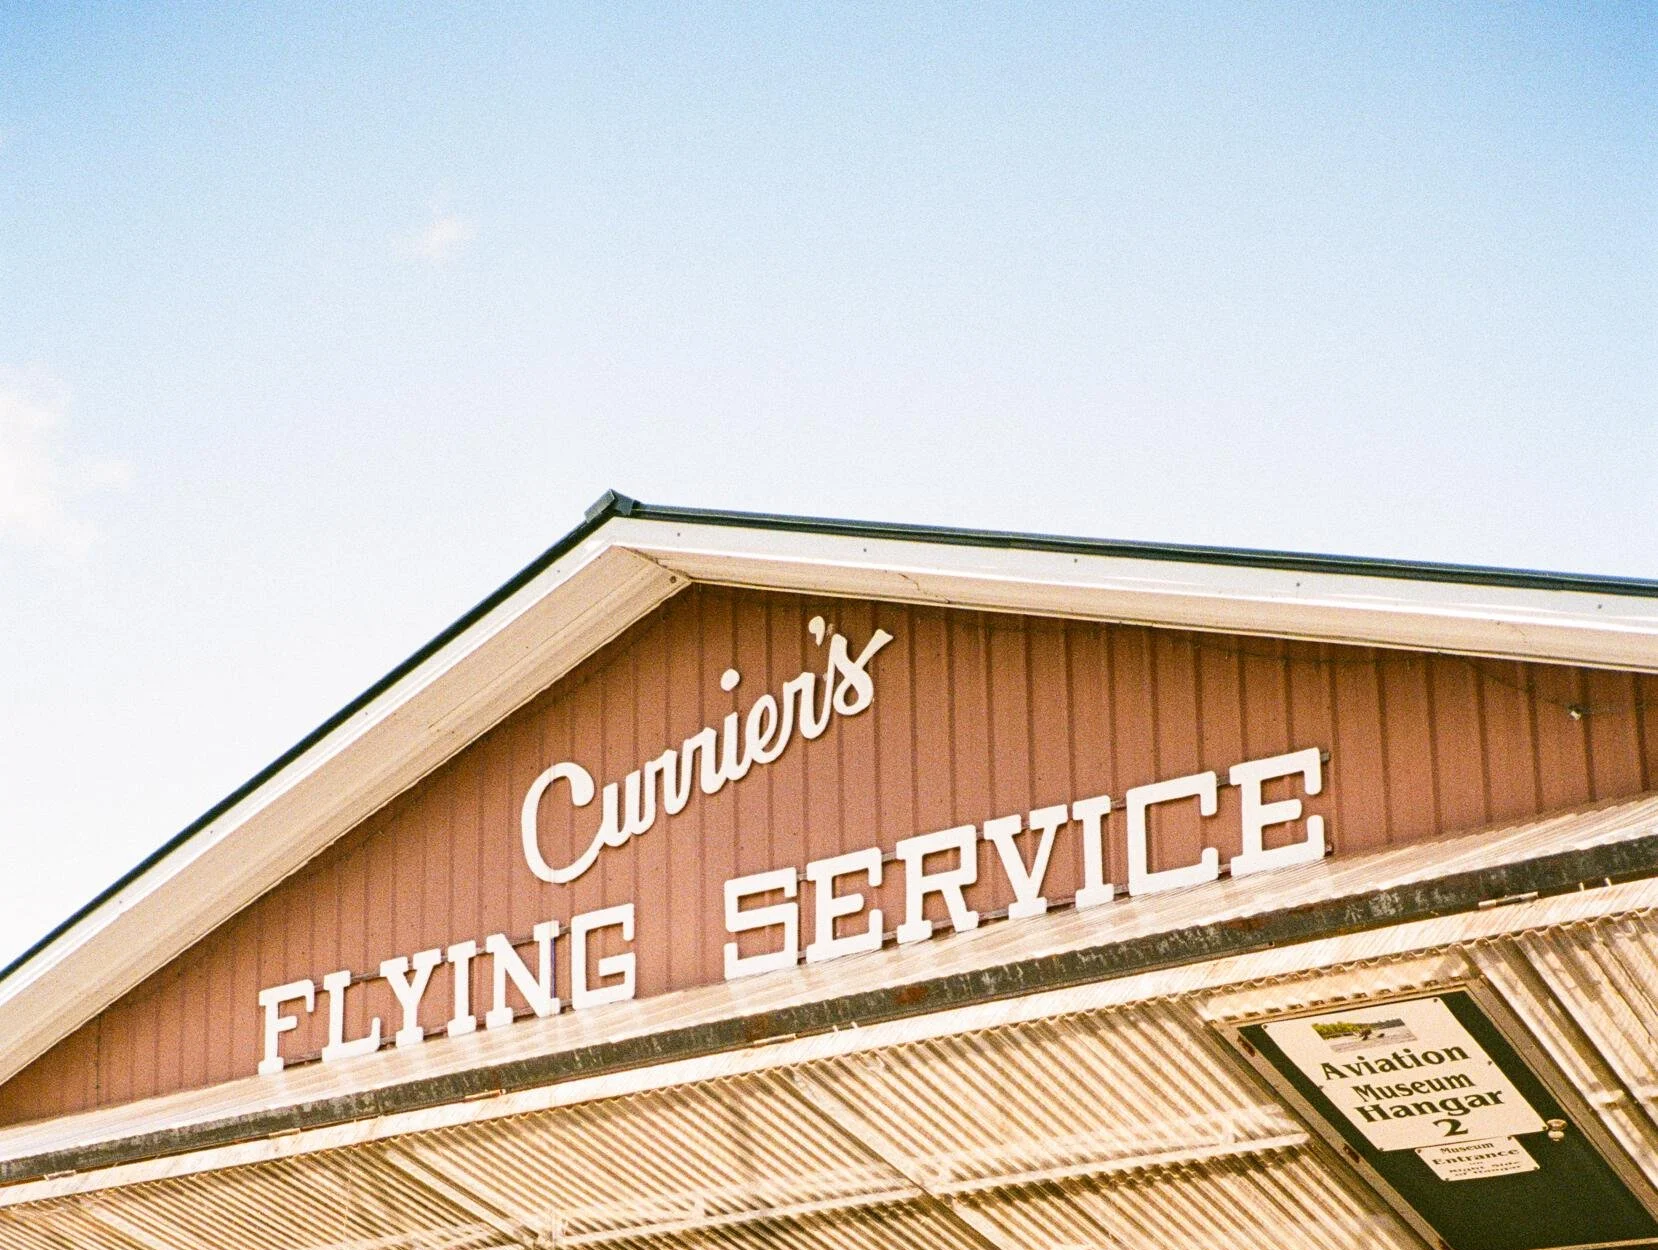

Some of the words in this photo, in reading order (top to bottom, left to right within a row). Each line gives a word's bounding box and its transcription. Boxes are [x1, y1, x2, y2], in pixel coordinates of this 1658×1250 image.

[521, 615, 894, 884] Currier's
[258, 903, 637, 1076] FLYING
[724, 747, 1326, 980] SERVICE
[1320, 1045, 1472, 1080] Aviation
[1351, 1072, 1477, 1102] Museum
[1354, 1090, 1505, 1123] Hangar
[1432, 1118, 1469, 1138] 2
[1431, 1149, 1521, 1165] Entrance
[1439, 1142, 1495, 1155] Museum
